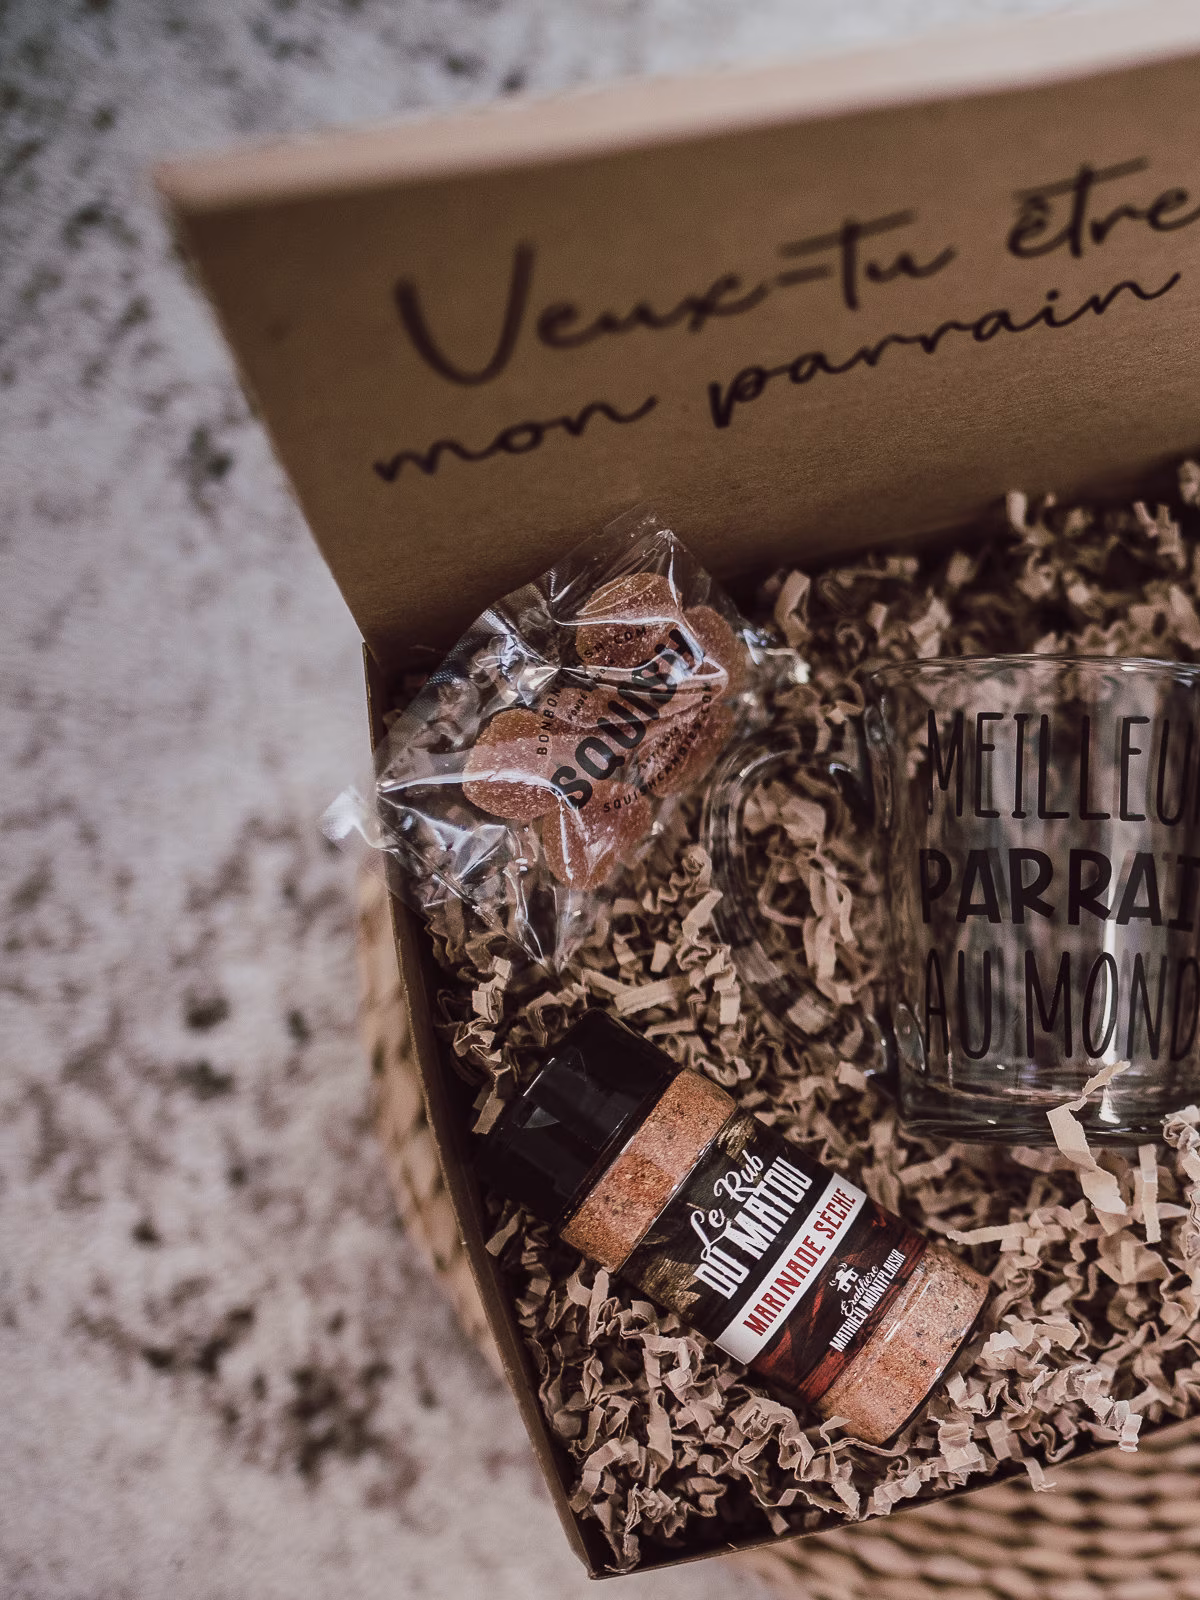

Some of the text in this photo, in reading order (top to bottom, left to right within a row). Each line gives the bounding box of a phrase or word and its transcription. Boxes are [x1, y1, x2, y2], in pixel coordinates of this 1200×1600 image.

[373, 393, 660, 483] mon
[550, 629, 703, 810] SQUISH
[924, 949, 992, 1060] AU
[690, 1149, 764, 1260] Le Rub
[693, 1156, 813, 1299] DU MATOU
[743, 1188, 856, 1337] MARINADE SÈCHE
[829, 1249, 906, 1352] MATHIEU MONTPLAISIR
